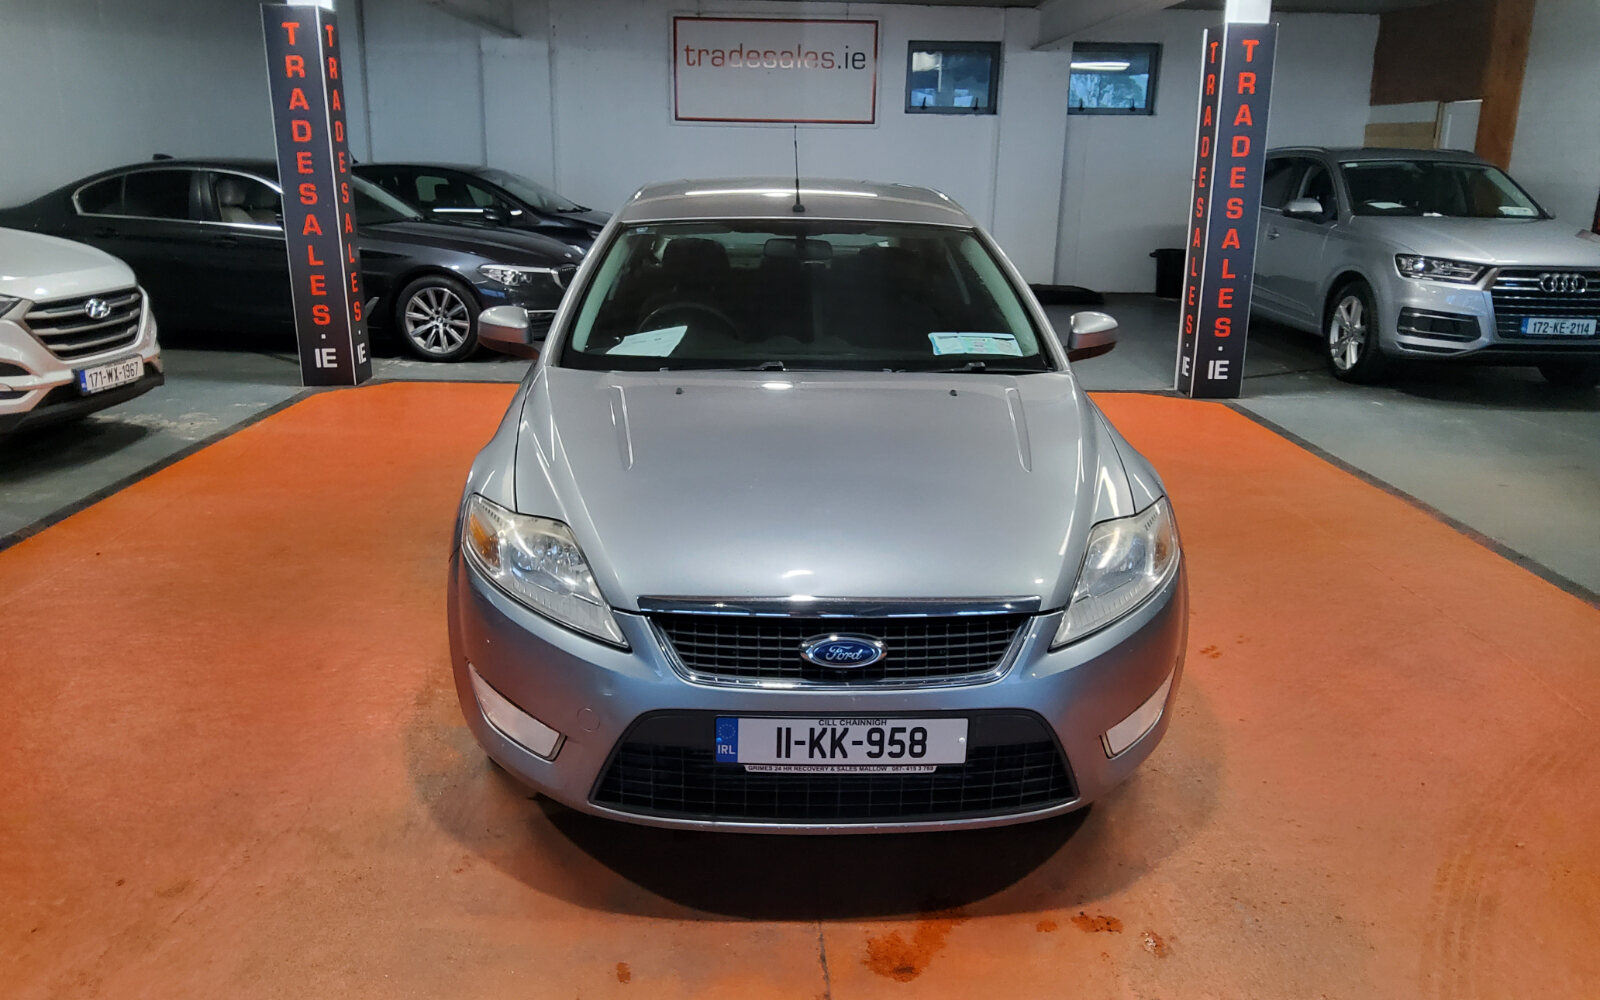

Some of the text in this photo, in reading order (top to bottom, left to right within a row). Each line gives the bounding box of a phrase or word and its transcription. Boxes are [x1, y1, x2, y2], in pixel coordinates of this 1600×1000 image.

[684, 43, 867, 70] tradesales.ie
[1532, 321, 1590, 334] 172-KE-2114
[89, 361, 138, 388] 171-WX-1967
[825, 645, 863, 661] Ford
[818, 719, 887, 727] CILL CHAINNIGH
[717, 744, 736, 756] IRL
[776, 727, 928, 759] 11-KK-958
